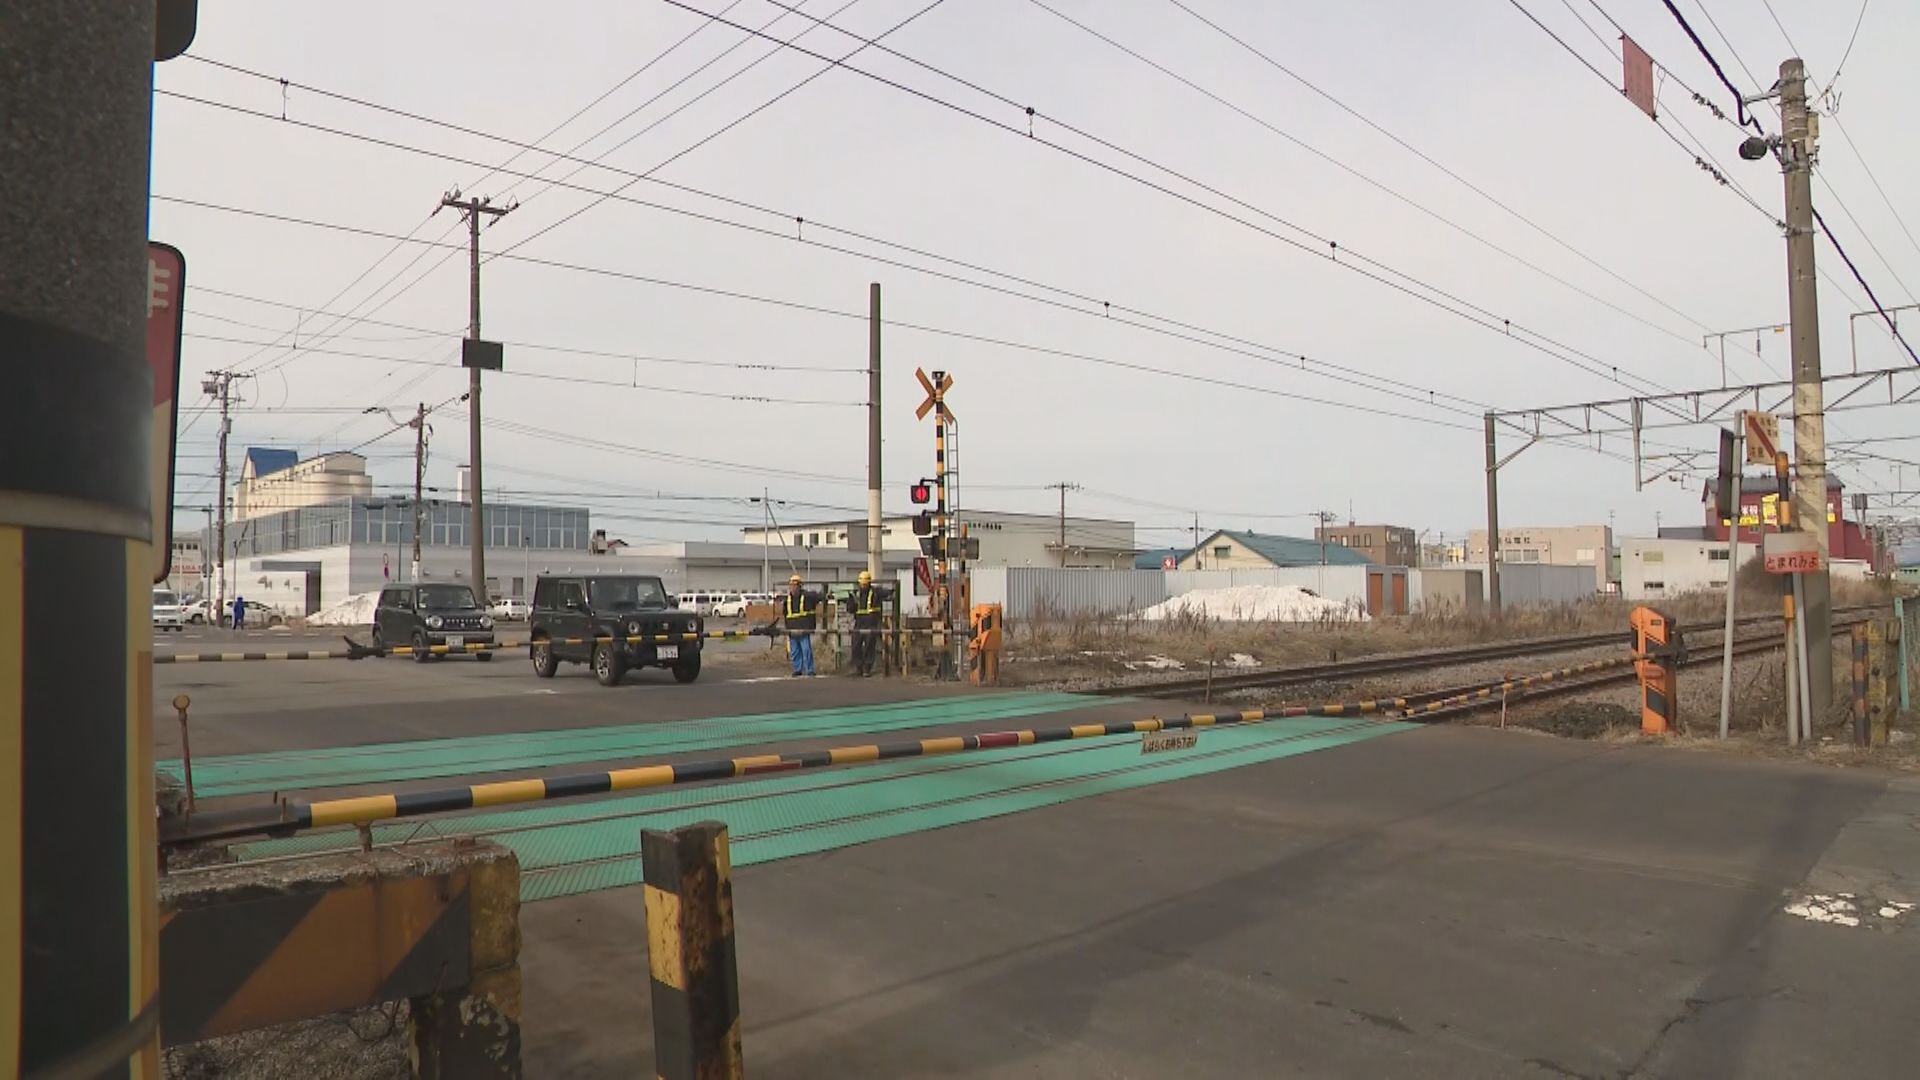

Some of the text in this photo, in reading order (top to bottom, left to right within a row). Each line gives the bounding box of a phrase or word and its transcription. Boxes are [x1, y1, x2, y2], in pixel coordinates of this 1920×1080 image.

[1767, 556, 1817, 570] とまれみよ
